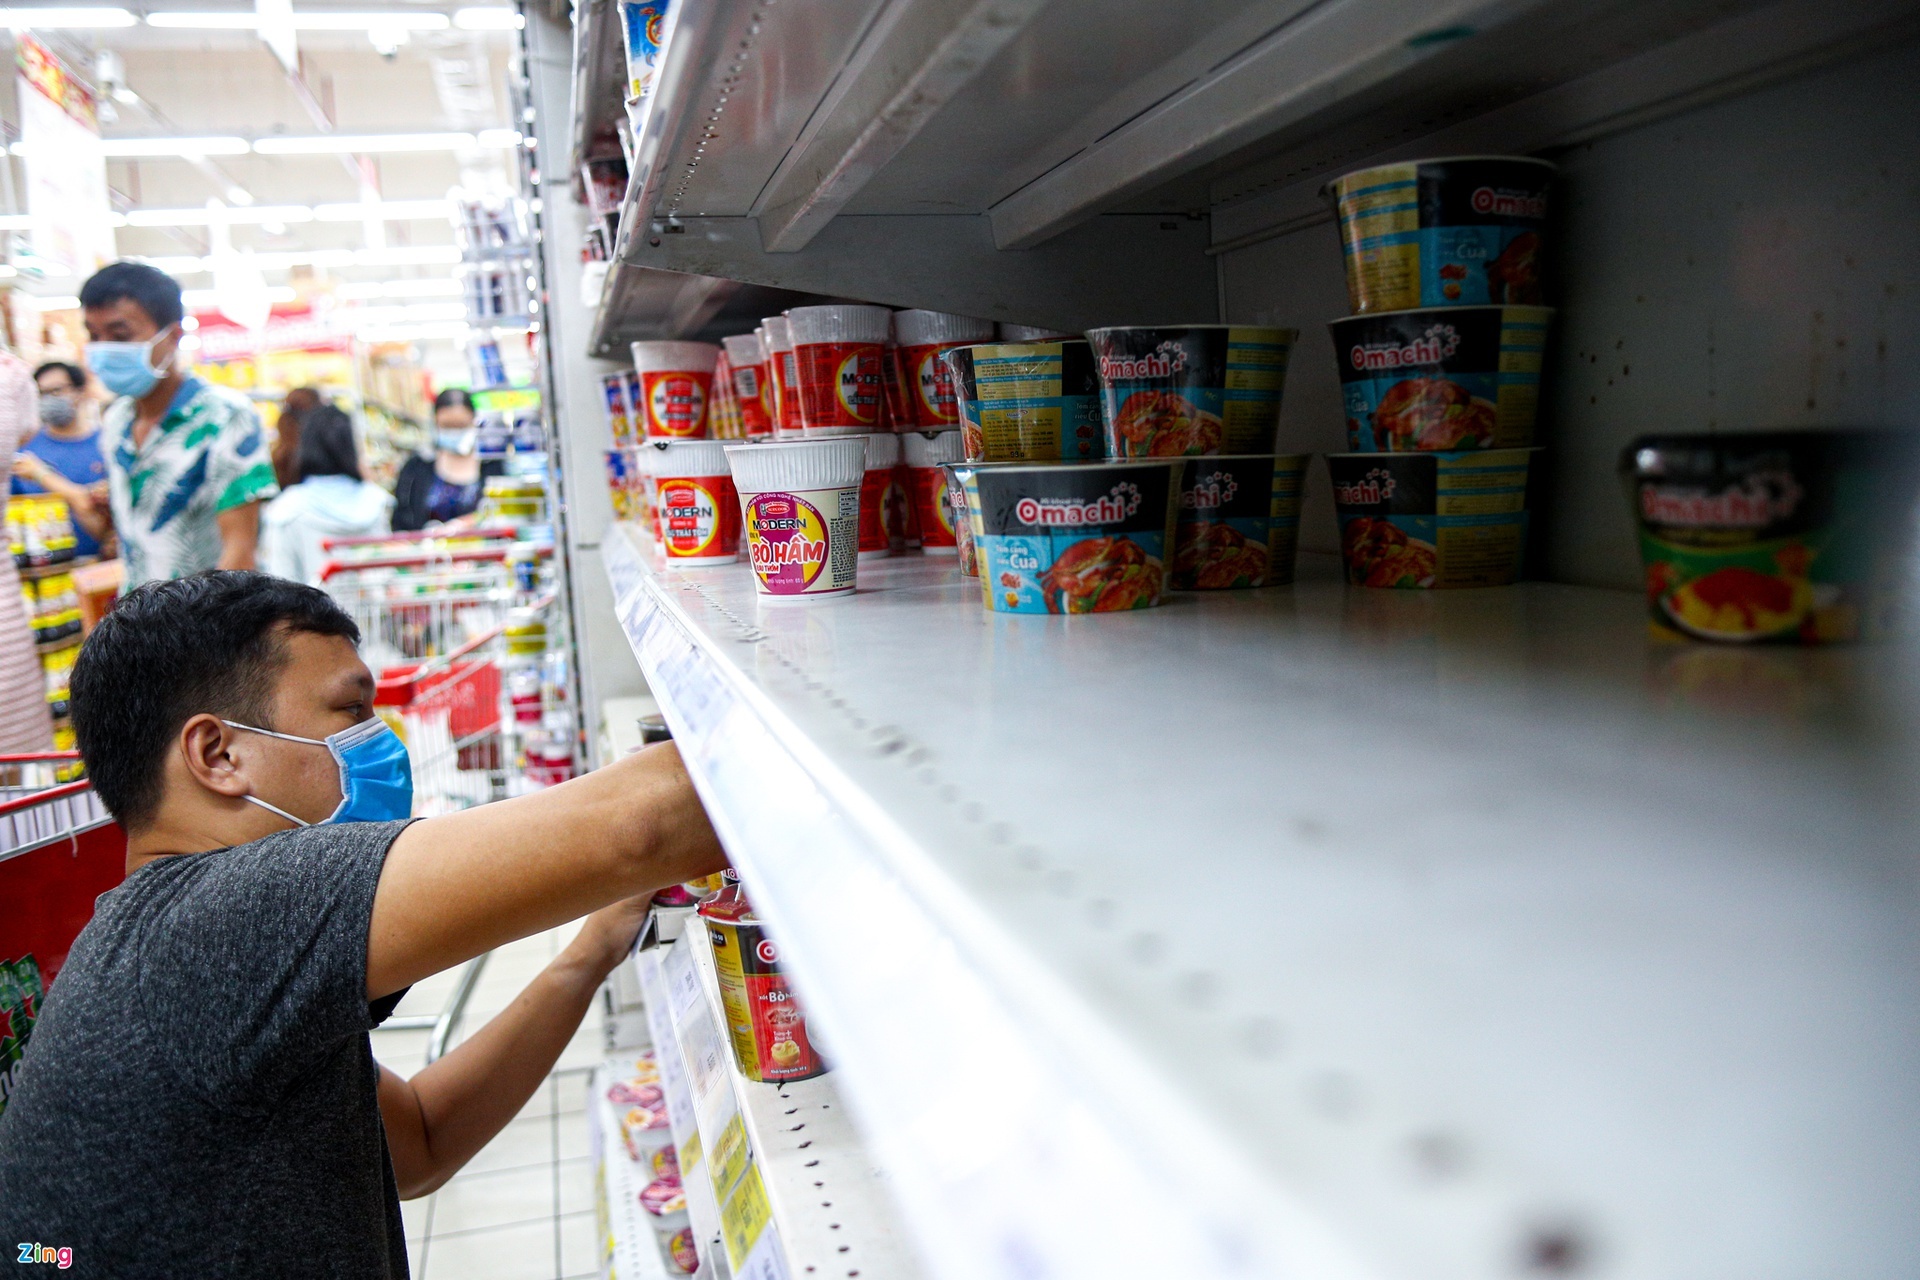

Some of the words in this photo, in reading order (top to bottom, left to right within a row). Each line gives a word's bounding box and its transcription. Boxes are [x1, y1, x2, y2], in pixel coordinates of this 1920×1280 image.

[1350, 336, 1443, 371] Omachi
[1100, 353, 1171, 379] Omachi
[1088, 410, 1101, 422] Cu
[1016, 495, 1126, 527] Omachi
[752, 518, 807, 530] MODERN
[751, 536, 771, 563] BÒ
[772, 533, 825, 564] HẦM
[1010, 553, 1039, 569] Cua
[769, 990, 786, 1003] Bò
